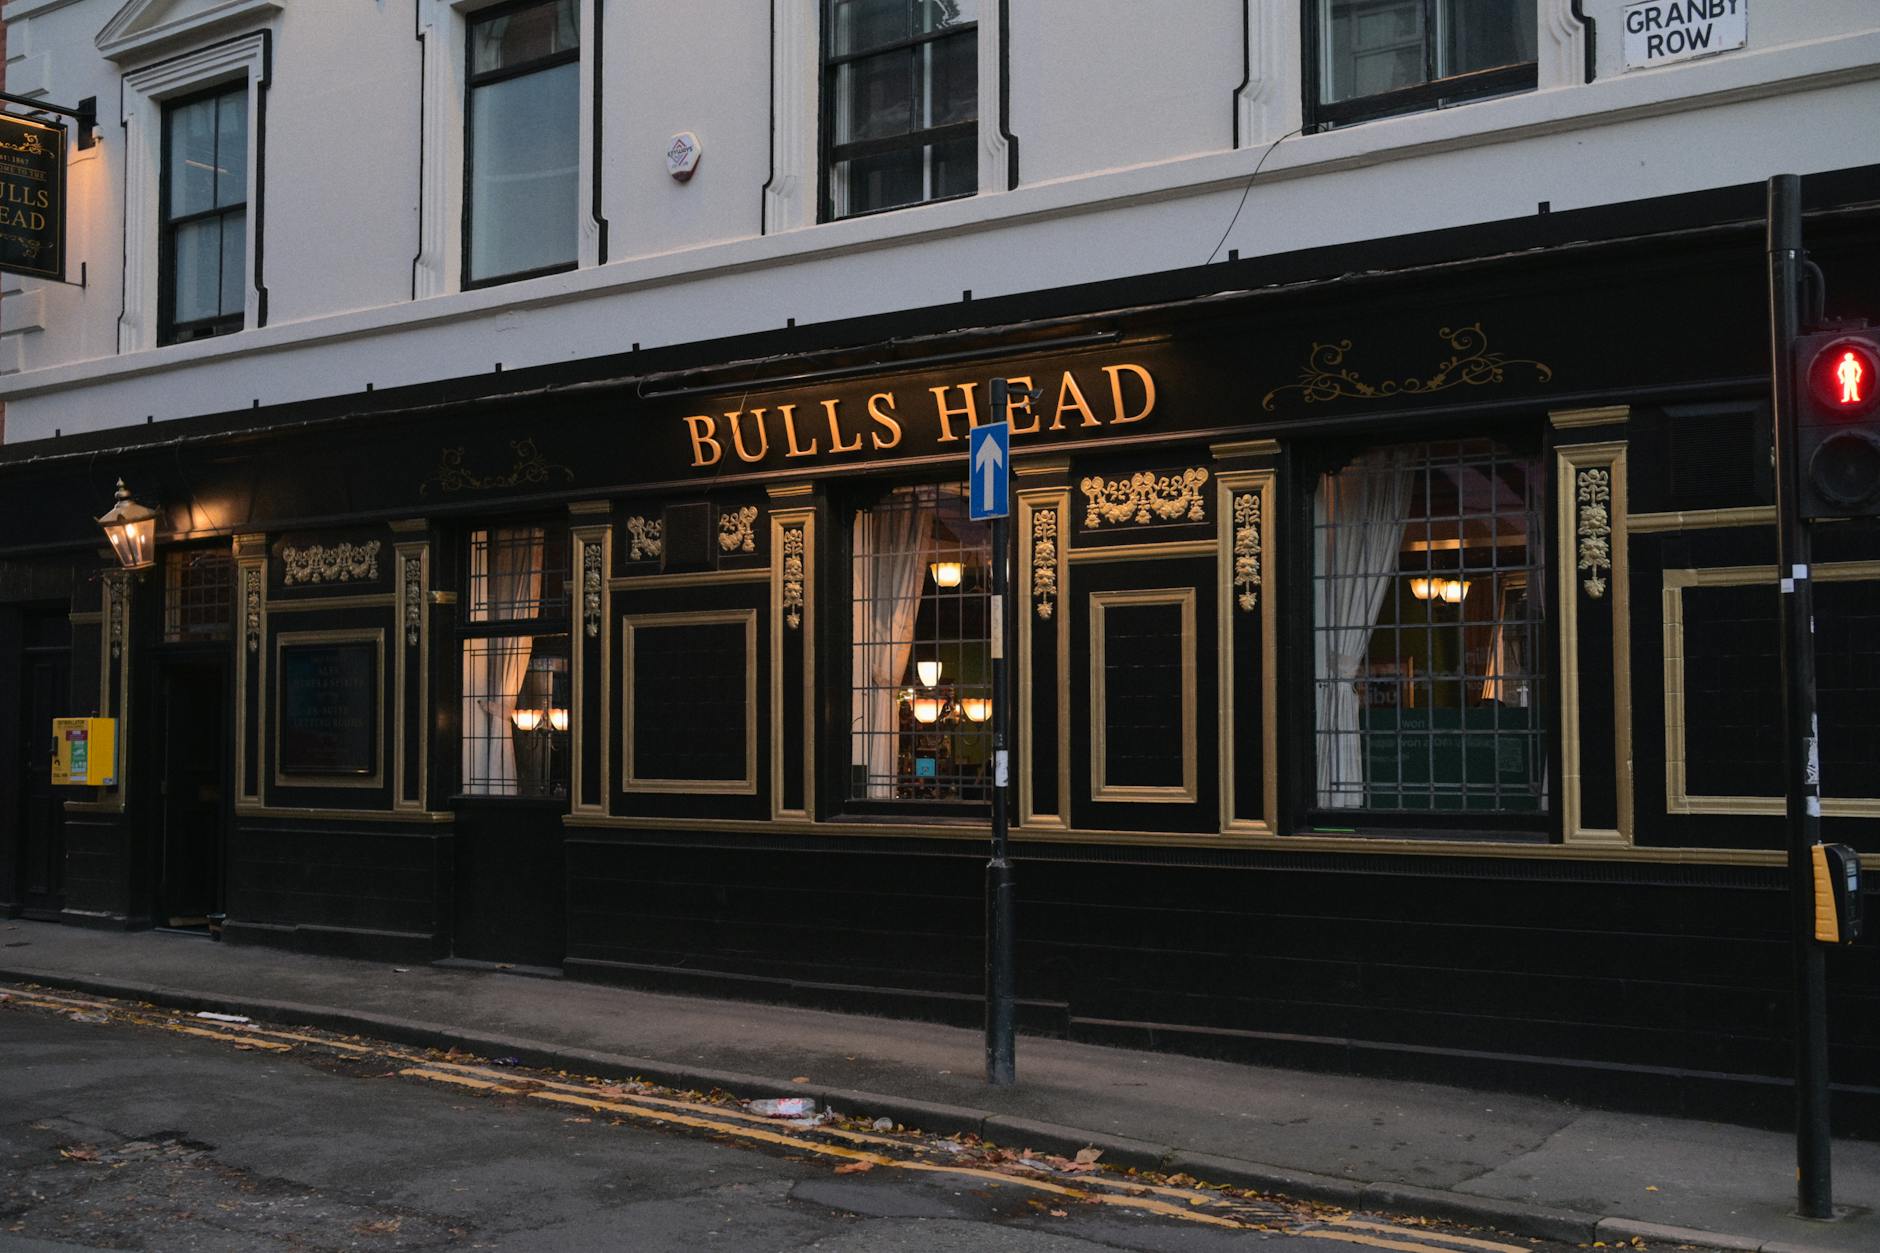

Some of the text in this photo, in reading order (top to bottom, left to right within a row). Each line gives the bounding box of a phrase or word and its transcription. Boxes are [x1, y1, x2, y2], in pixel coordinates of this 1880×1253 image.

[1626, 0, 1738, 34] GRANBY
[1647, 23, 1713, 59] ROW
[683, 363, 1156, 467] BULLS HEAD
